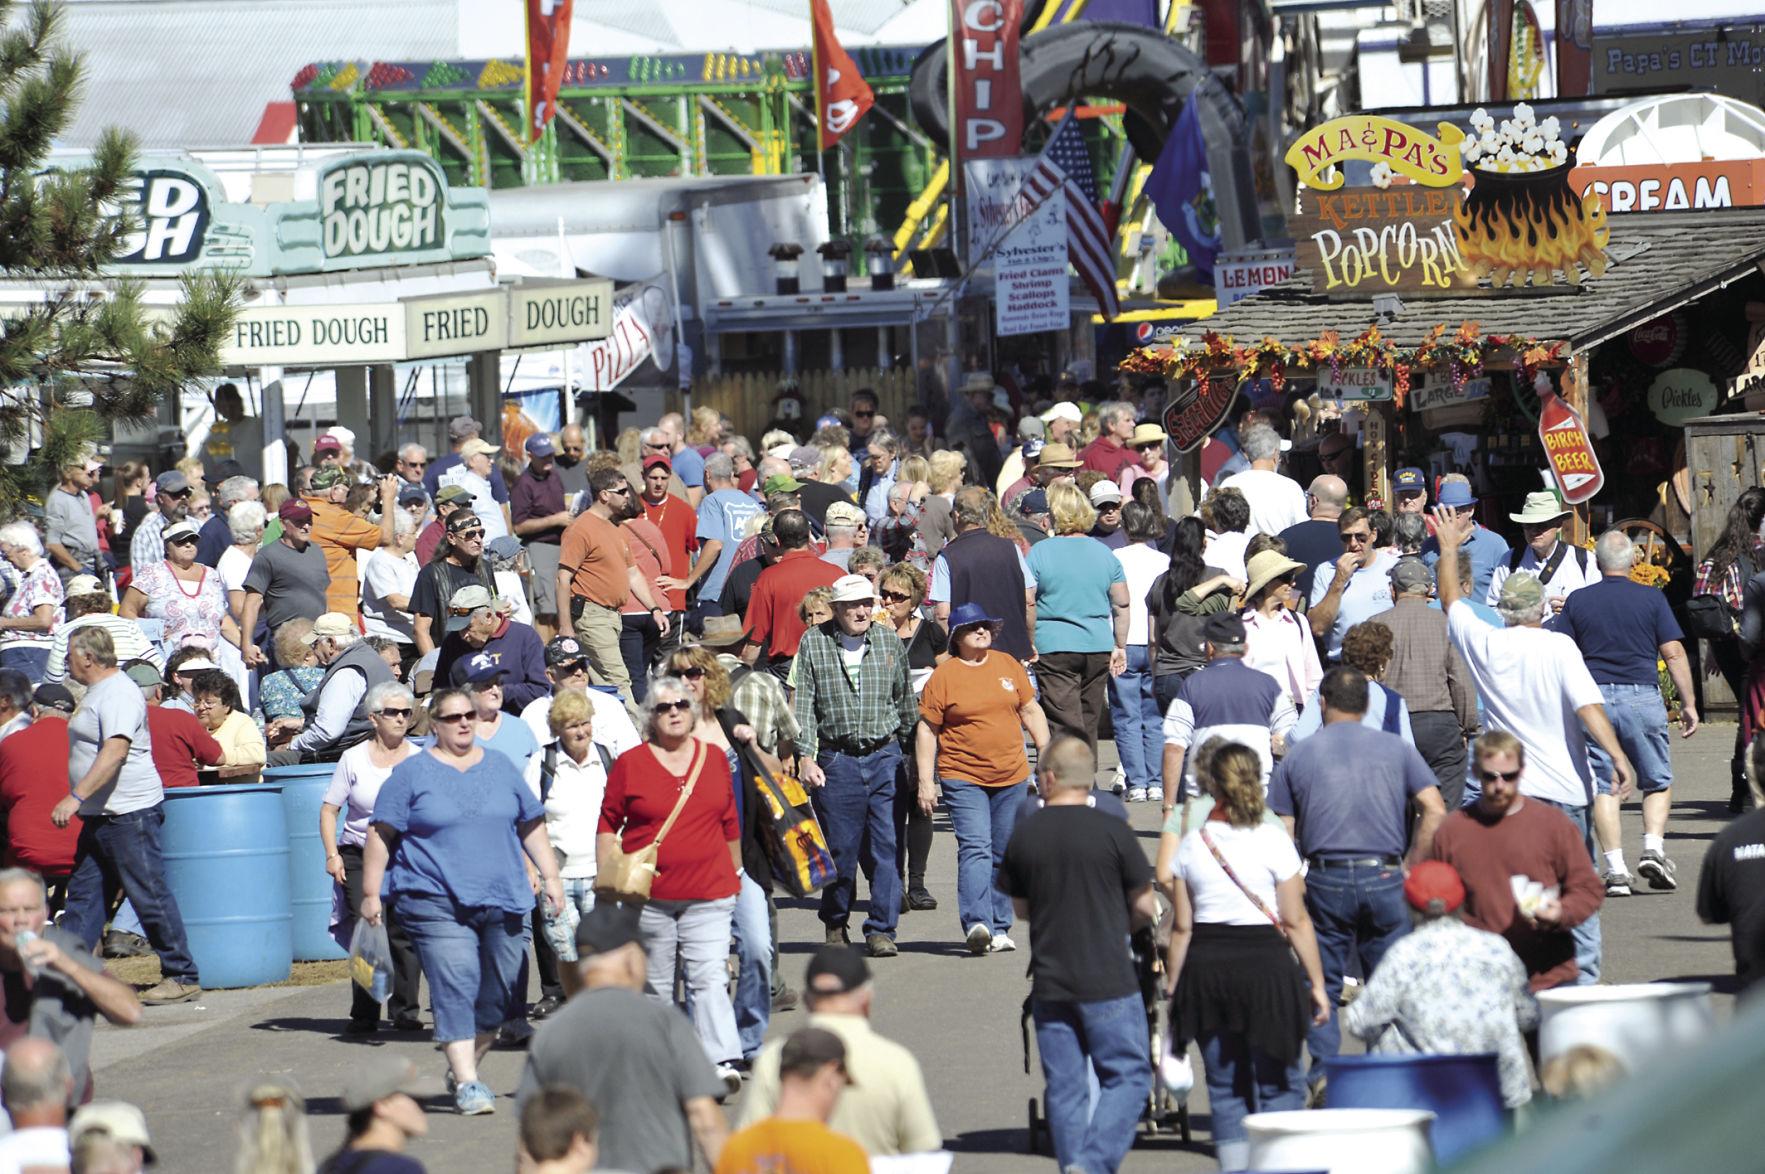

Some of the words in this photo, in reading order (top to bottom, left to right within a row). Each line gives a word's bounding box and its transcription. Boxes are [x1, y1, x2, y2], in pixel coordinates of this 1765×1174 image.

[1607, 48, 1681, 75] Papa's
[1689, 42, 1718, 68] CT
[323, 163, 436, 217] FRIED
[1317, 191, 1449, 230] KETTLE
[324, 203, 436, 257] DOUGH
[996, 243, 1065, 258] Sylvester's
[1310, 219, 1469, 290] POPCORN
[999, 270, 1027, 281] Fried
[1030, 267, 1064, 278] Clams
[1012, 280, 1052, 290] Shrimp
[1222, 265, 1299, 289] LEMON
[1007, 300, 1058, 312] Haddock
[1008, 290, 1056, 301] Scallops
[424, 307, 489, 342] FRIED
[527, 296, 600, 330] DOUGH
[236, 319, 300, 348] FRIED
[312, 317, 389, 345] DOUGH
[1330, 371, 1376, 386] CKLES
[1662, 387, 1702, 409] Pickles
[1544, 431, 1585, 450] BIRCH
[1554, 451, 1595, 472] BEER
